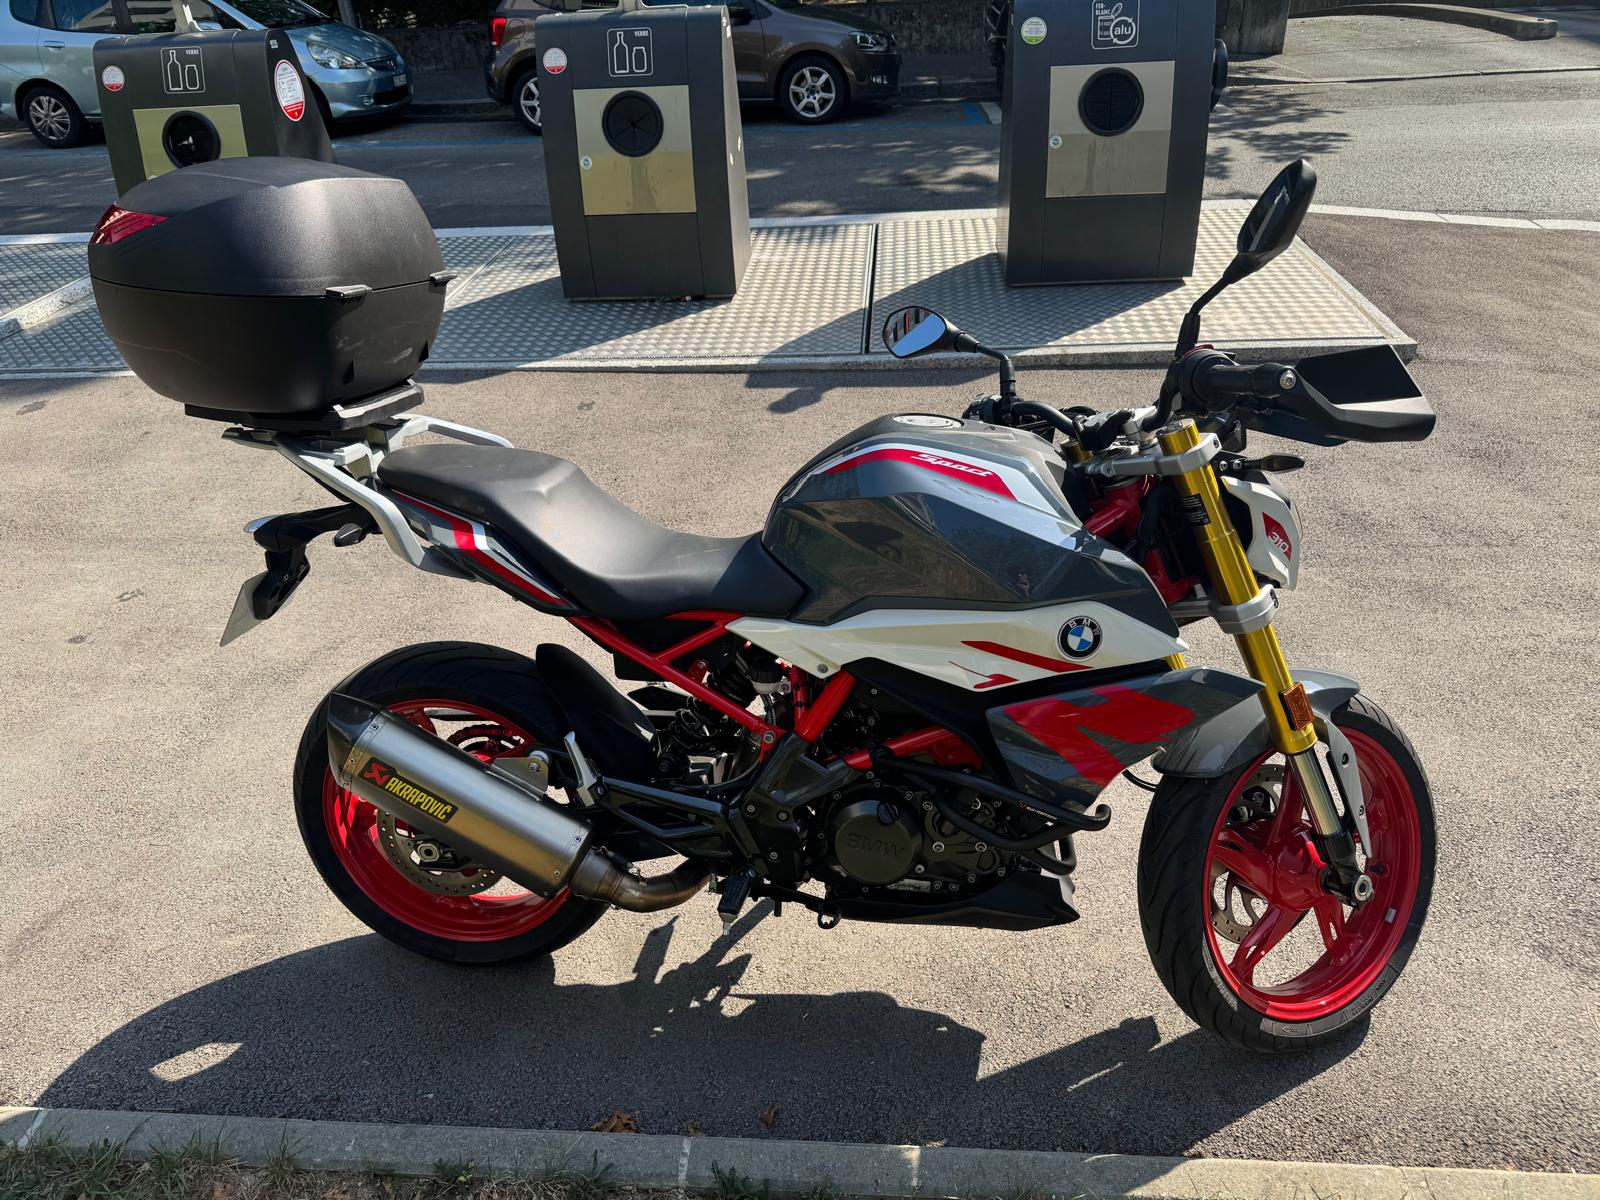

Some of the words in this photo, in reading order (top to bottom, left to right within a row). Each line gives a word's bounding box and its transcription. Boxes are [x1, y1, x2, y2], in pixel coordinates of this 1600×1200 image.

[1114, 25, 1131, 35] alu
[911, 453, 994, 477] Sport
[1269, 531, 1289, 552] 310
[1069, 618, 1101, 636] BMW
[384, 777, 452, 820] AKRAPOVIČ
[846, 832, 906, 857] BMW
